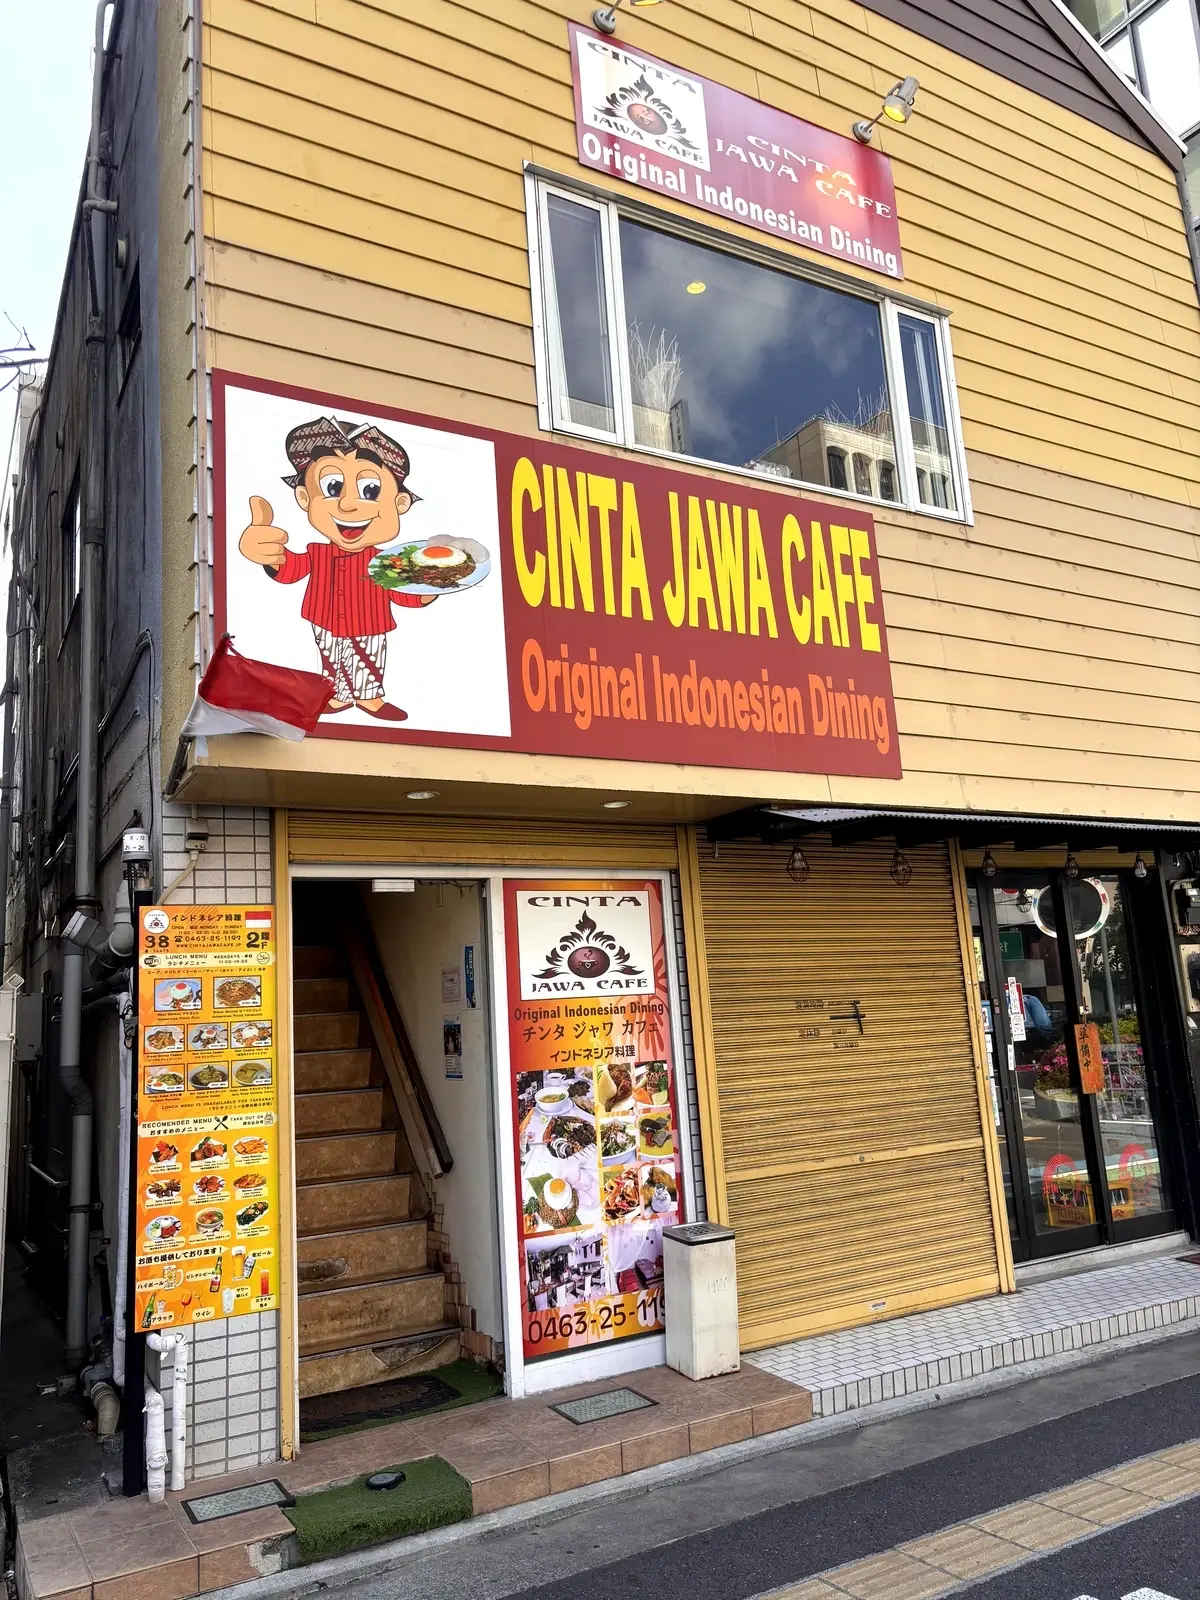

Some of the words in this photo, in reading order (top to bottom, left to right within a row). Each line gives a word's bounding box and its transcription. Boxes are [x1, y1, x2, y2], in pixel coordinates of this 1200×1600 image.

[587, 41, 697, 95] CINTA
[593, 113, 644, 141] JAWA
[655, 139, 704, 165] CAFE
[747, 135, 857, 187] CINTA
[715, 137, 799, 183] JAWA
[816, 179, 892, 219] CAFE
[582, 133, 687, 194] Original
[696, 175, 823, 245] Indonesian
[830, 225, 898, 275] Dining
[511, 457, 653, 621] CINTA
[662, 491, 778, 639] JAWA
[782, 513, 882, 653] CAFE
[521, 638, 647, 730] Original
[652, 655, 805, 735] Indonesian
[808, 673, 890, 755] Dining
[527, 896, 642, 908] CINTA
[171, 914, 242, 922] インドネシア料理
[144, 935, 170, 949] 38
[532, 981, 586, 993] JAWA
[597, 978, 648, 989] CAFE
[514, 1006, 560, 1024] Original
[564, 1002, 627, 1018] Indonesian
[630, 1001, 665, 1015] Dining
[523, 1023, 565, 1043] チンタ
[573, 1021, 614, 1040] ジャワ
[622, 1019, 659, 1035] カフェ
[550, 1045, 636, 1063] インドネシア料理
[142, 1119, 190, 1129] RECOMENDED
[150, 1126, 205, 1136] おすすめのメニュー
[138, 1246, 222, 1265] お酒も提供しております！
[195, 1310, 211, 1318] ワイン
